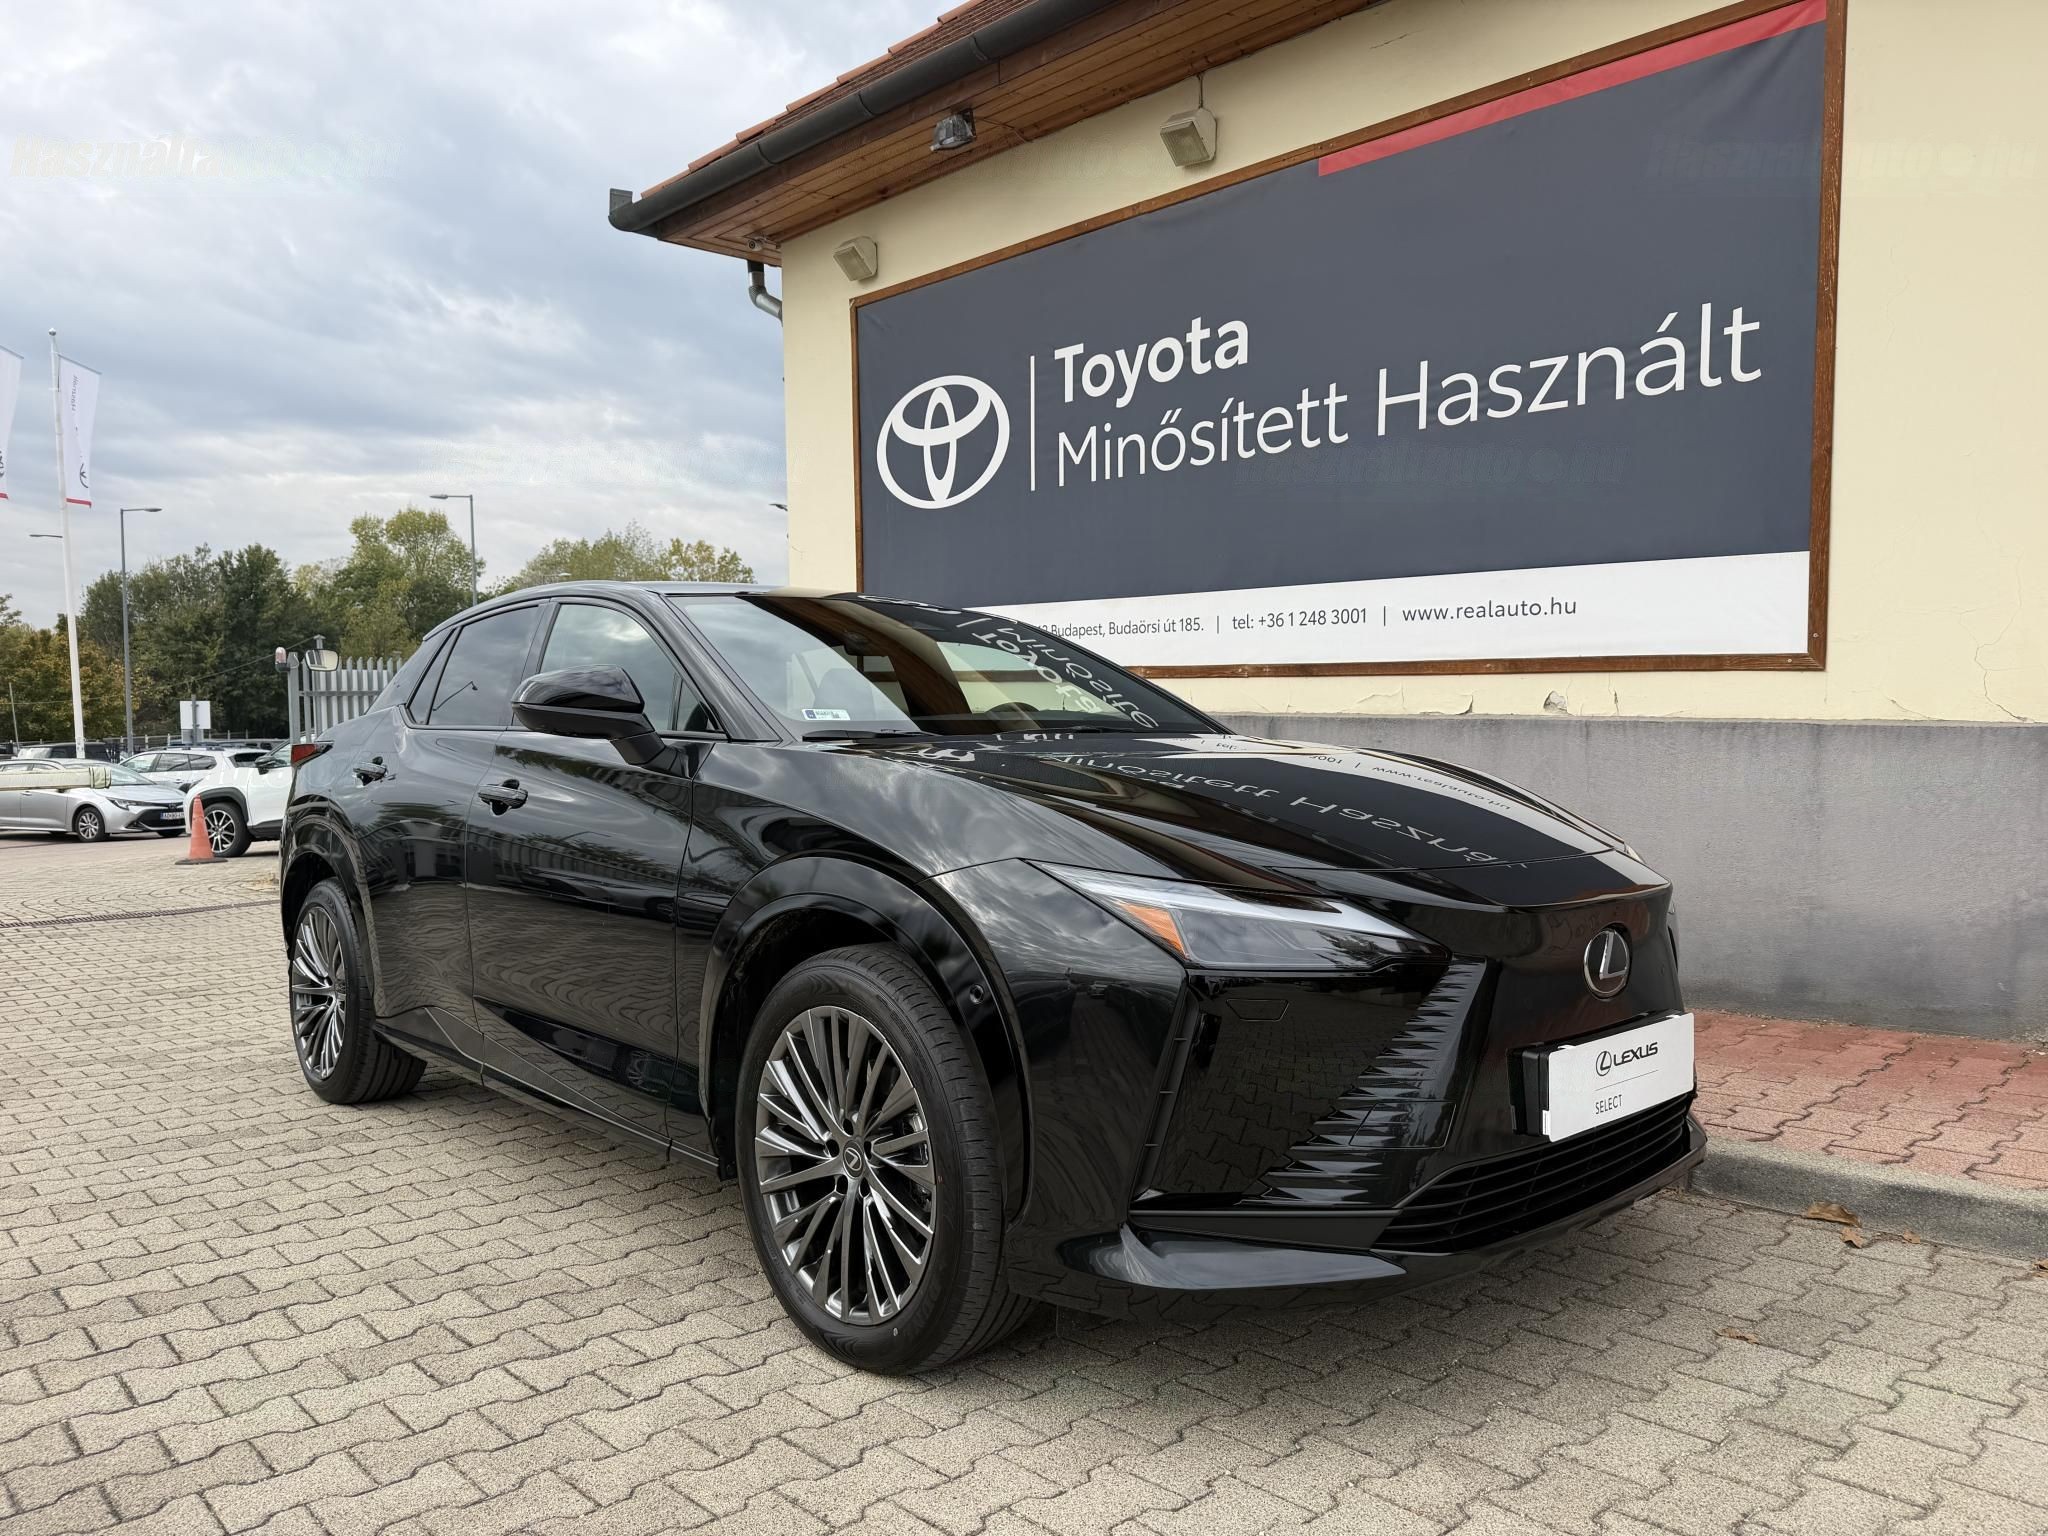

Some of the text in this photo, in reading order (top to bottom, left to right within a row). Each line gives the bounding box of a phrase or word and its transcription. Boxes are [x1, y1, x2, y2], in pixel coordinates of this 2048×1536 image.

[1054, 317, 1249, 408] Toyota
[1058, 302, 1762, 487] Minősített Használt
[1232, 614, 1254, 629] tel:
[1258, 612, 1285, 628] +36
[1299, 610, 1327, 626] 248
[1331, 608, 1366, 625] 3001
[1402, 597, 1576, 621] www.realauto.hu
[1051, 622, 1106, 638] Budapest,
[1109, 619, 1160, 635] Budaörsi
[1163, 617, 1177, 633] út
[1180, 617, 1204, 632] 185.
[1613, 1042, 1658, 1066] LEXUS
[1595, 1094, 1622, 1114] SELECT
